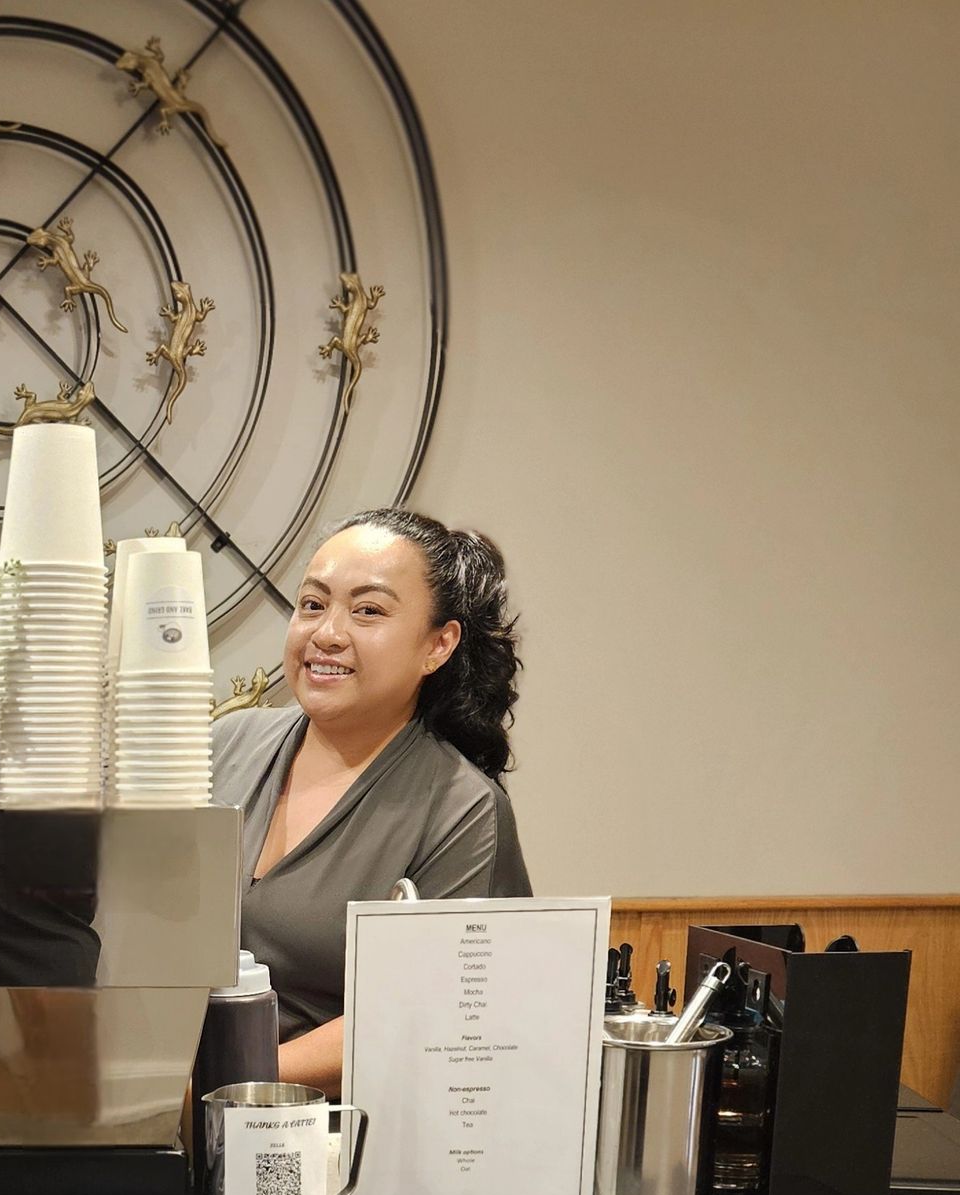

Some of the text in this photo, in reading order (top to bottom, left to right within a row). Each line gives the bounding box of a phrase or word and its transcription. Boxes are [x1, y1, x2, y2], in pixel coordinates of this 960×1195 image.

[465, 924, 487, 932] MENU
[460, 976, 488, 984] Espresso
[458, 1001, 472, 1009] Dirty
[244, 1120, 281, 1129] THANKS
[462, 1120, 474, 1128] Tea
